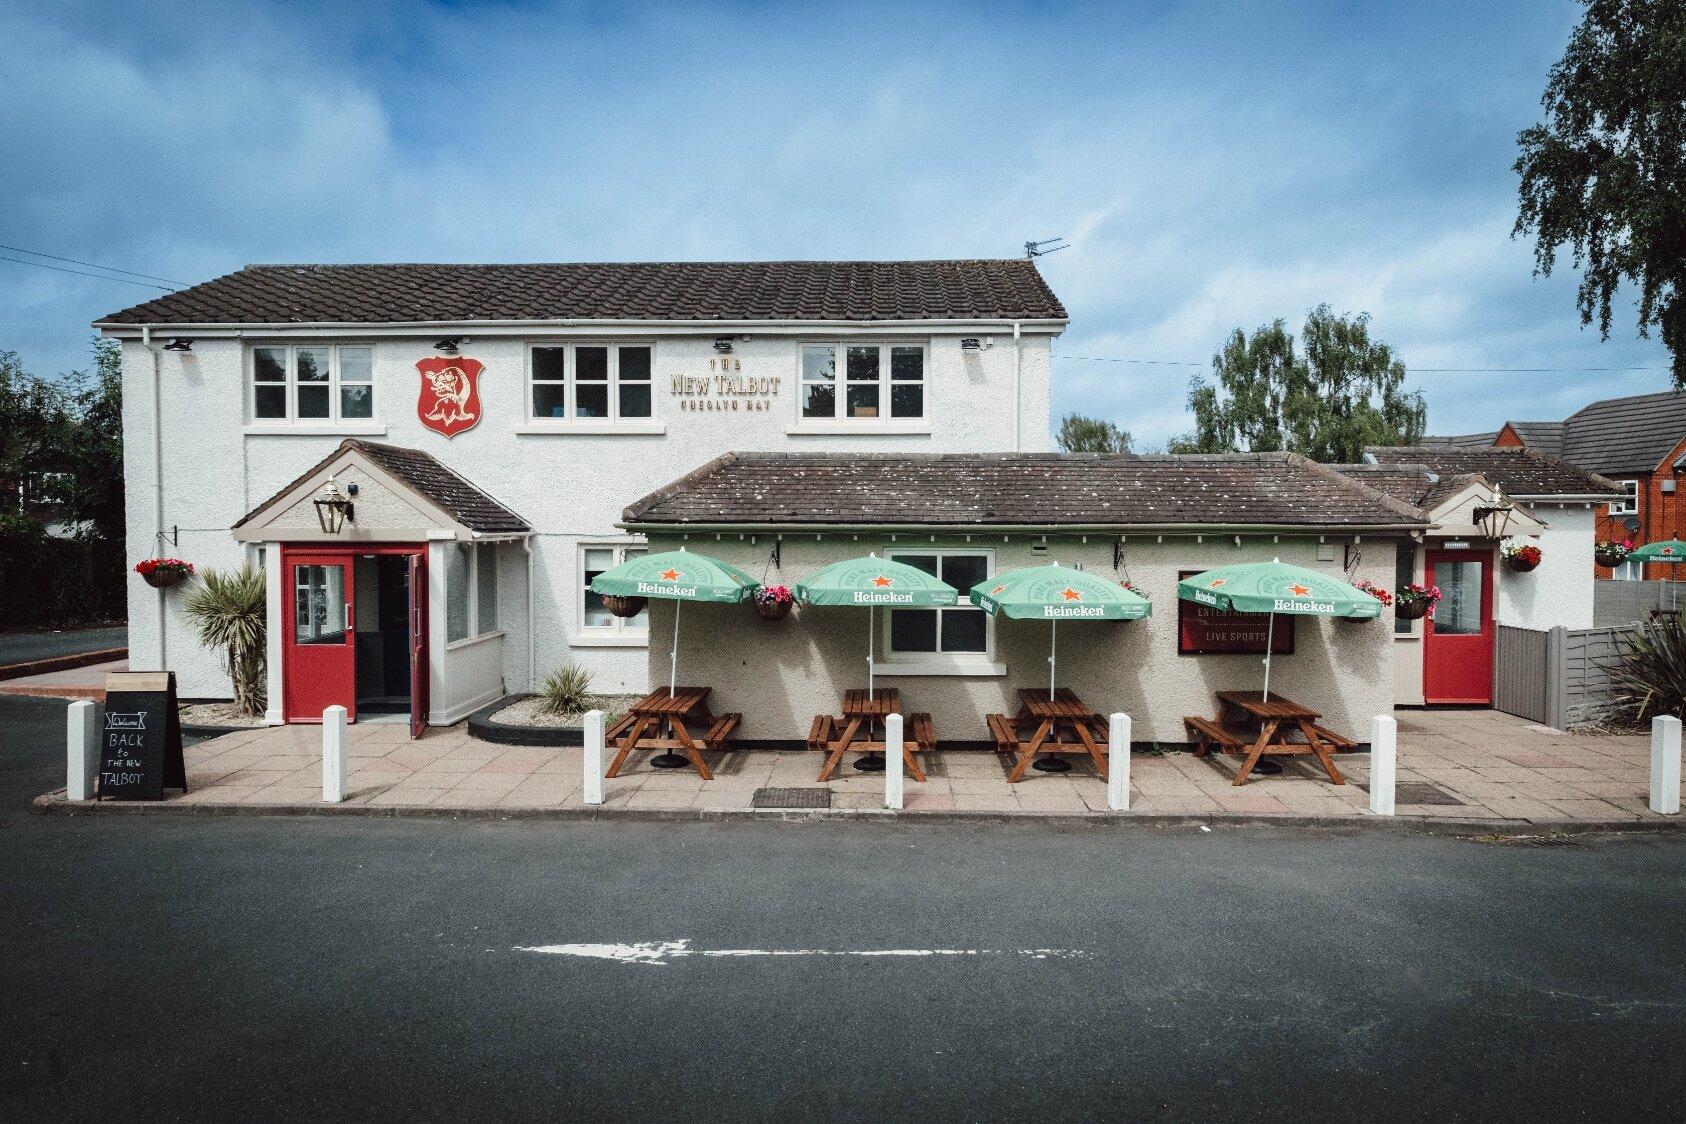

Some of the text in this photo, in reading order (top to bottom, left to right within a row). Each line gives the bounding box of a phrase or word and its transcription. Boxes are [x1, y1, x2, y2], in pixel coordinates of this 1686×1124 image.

[709, 359, 741, 371] THE
[670, 374, 781, 396] NEW TALBOT
[637, 582, 697, 597] Heineken
[854, 592, 913, 603] Heineken
[1195, 589, 1217, 605] Heineken
[1044, 605, 1104, 617] Heineken
[1274, 599, 1335, 613] Heineken
[1206, 632, 1266, 641] LIVE SPORTS
[113, 717, 138, 726] Welcome
[109, 734, 144, 747] BACK
[117, 747, 129, 758] to
[107, 759, 141, 768] THE NEW
[102, 771, 145, 786] TALBOT
